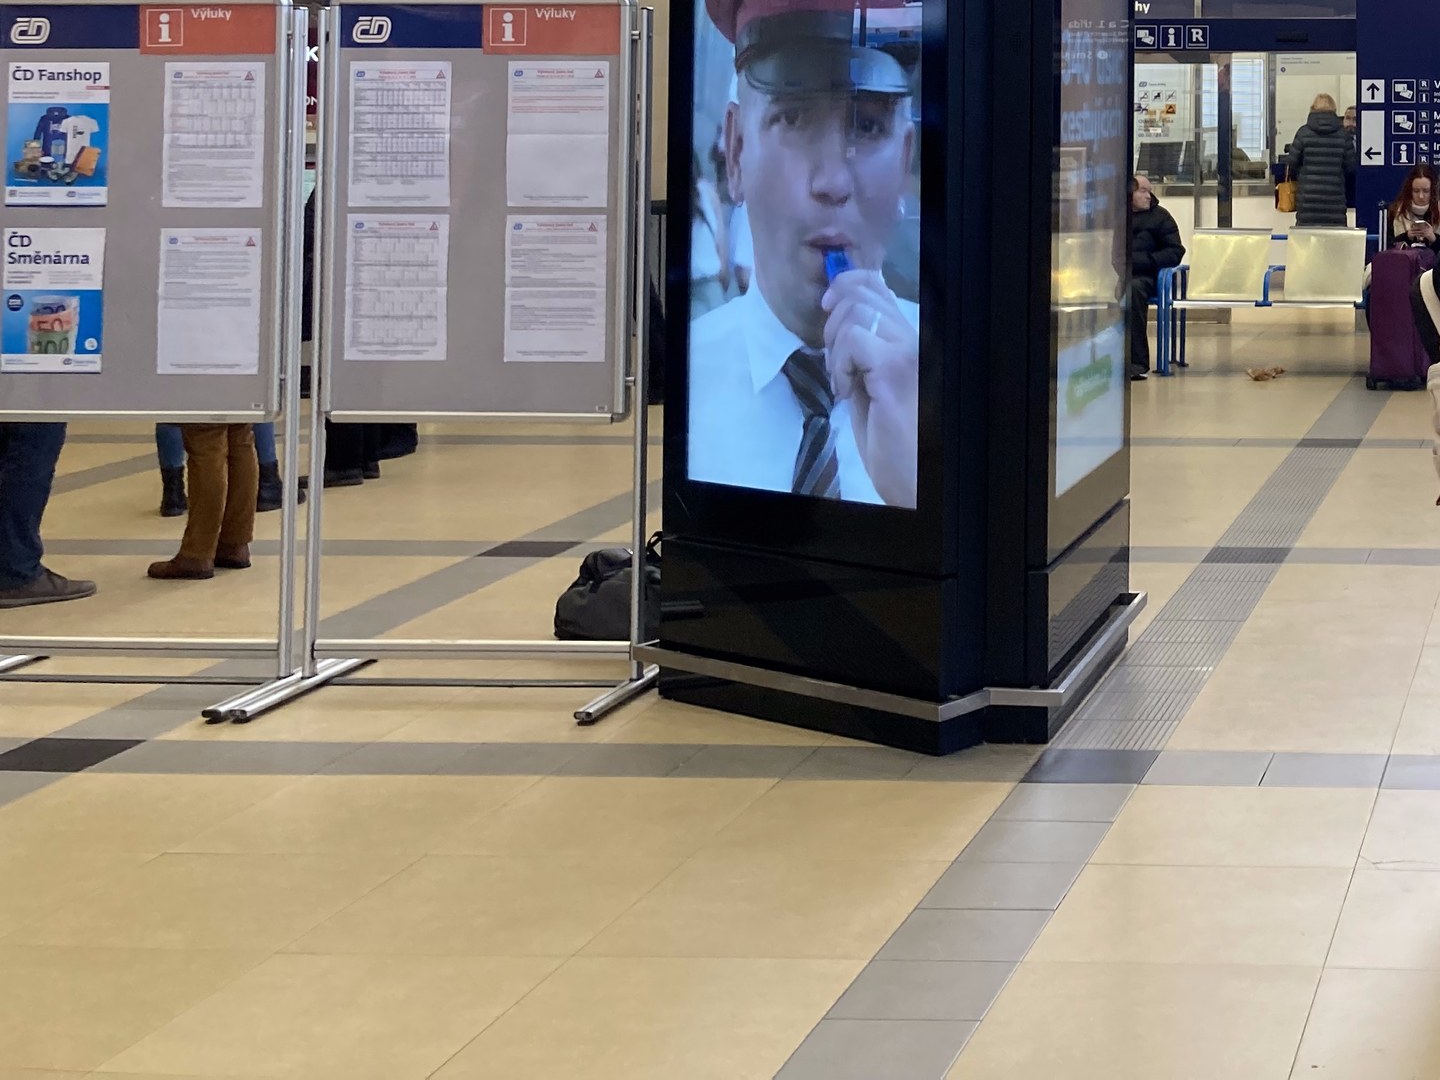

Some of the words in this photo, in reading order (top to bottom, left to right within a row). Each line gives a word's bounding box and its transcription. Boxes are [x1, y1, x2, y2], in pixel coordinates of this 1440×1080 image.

[191, 8, 232, 21] Výluky
[535, 8, 576, 20] Výluky
[12, 66, 34, 81] ČD
[38, 68, 101, 84] Fanshop
[8, 232, 32, 248] ČD
[7, 250, 90, 265] Směnárna
